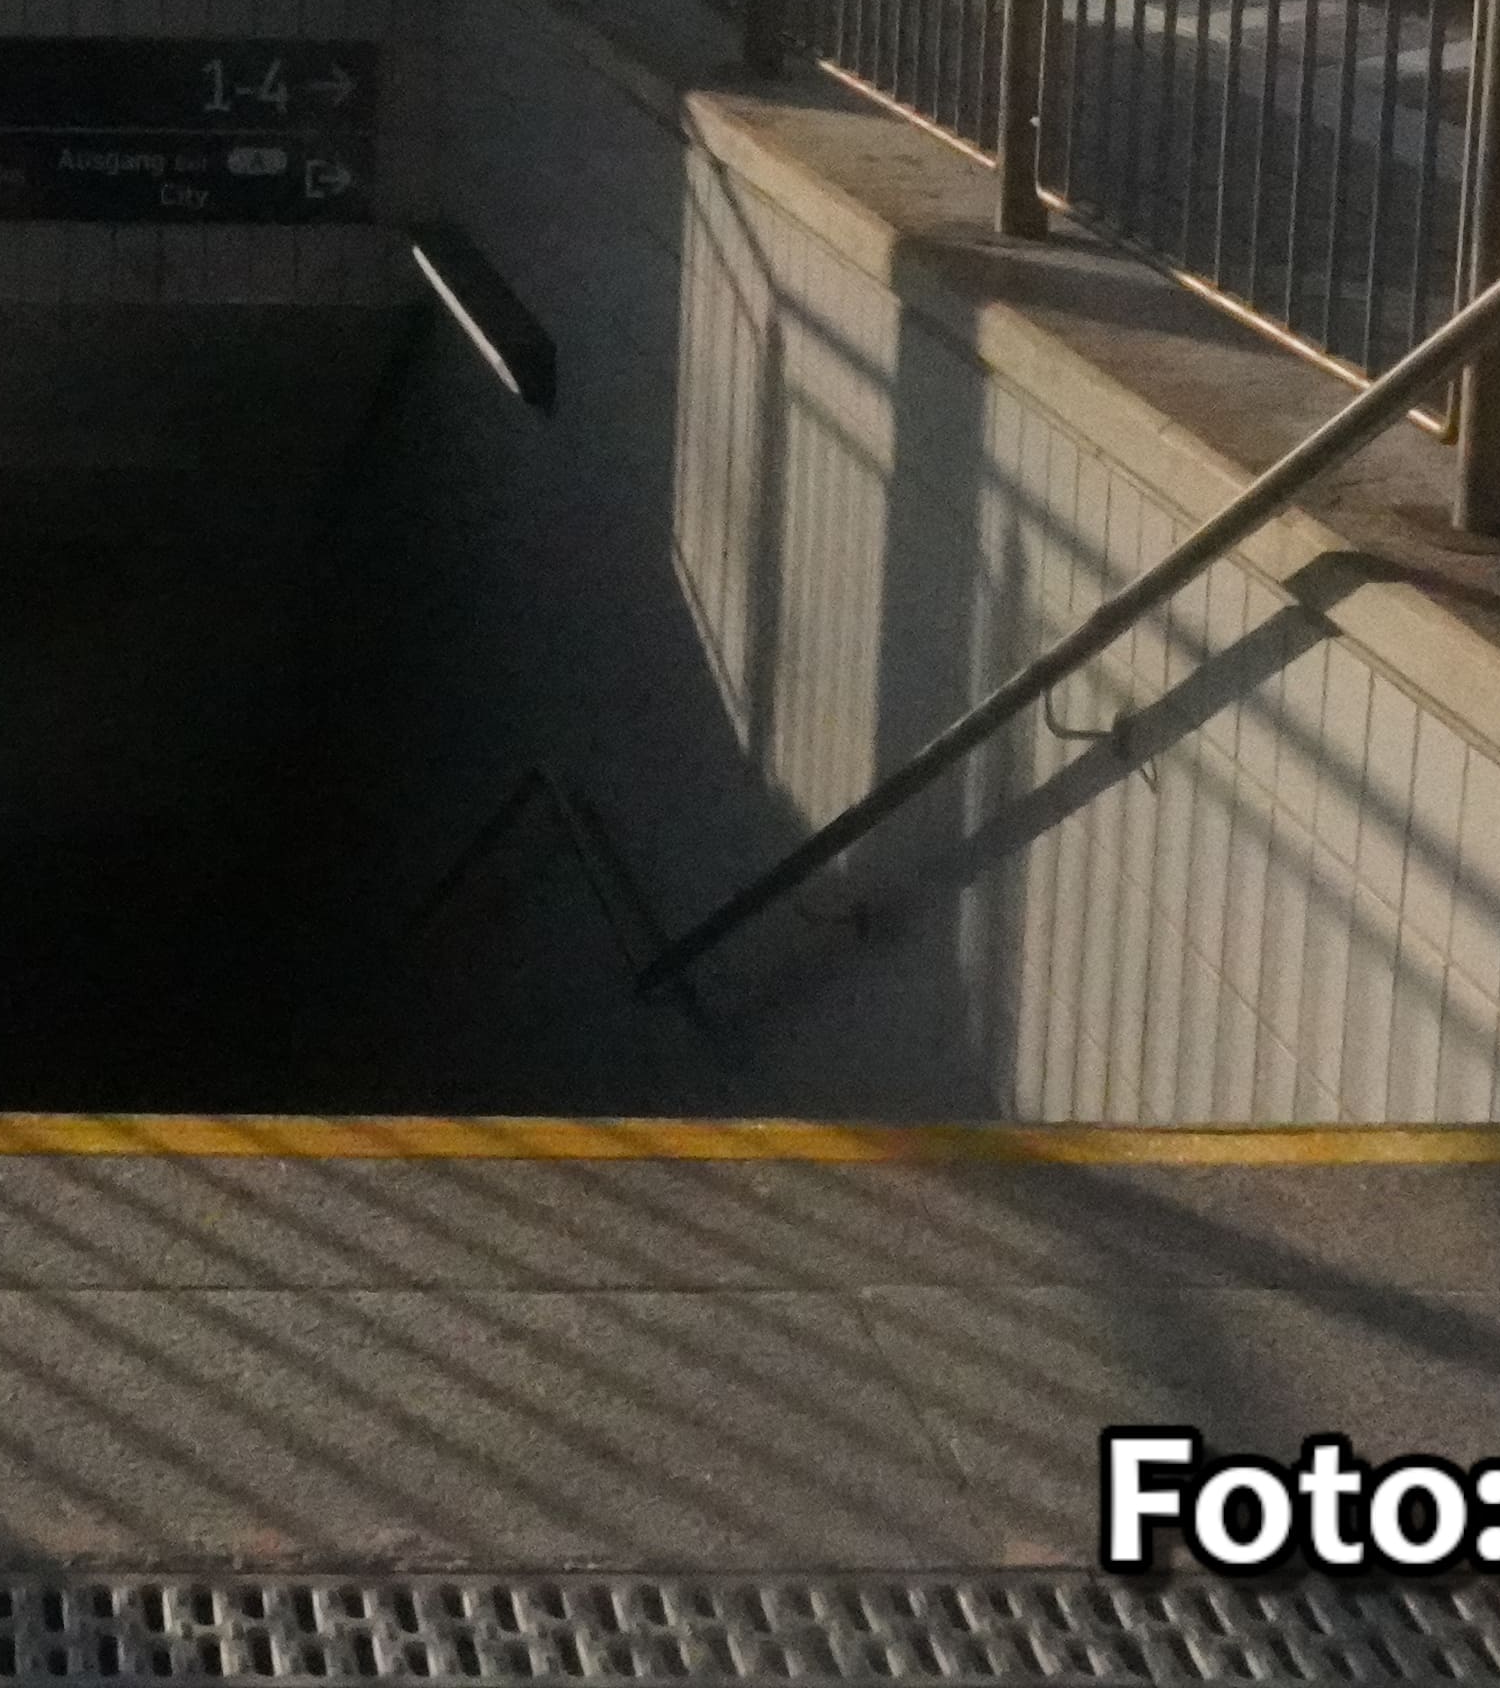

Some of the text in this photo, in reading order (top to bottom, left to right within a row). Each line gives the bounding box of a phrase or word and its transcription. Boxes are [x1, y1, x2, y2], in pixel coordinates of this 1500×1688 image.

[202, 58, 290, 114] 1-4
[57, 148, 165, 177] Ausgang
[158, 182, 208, 209] City
